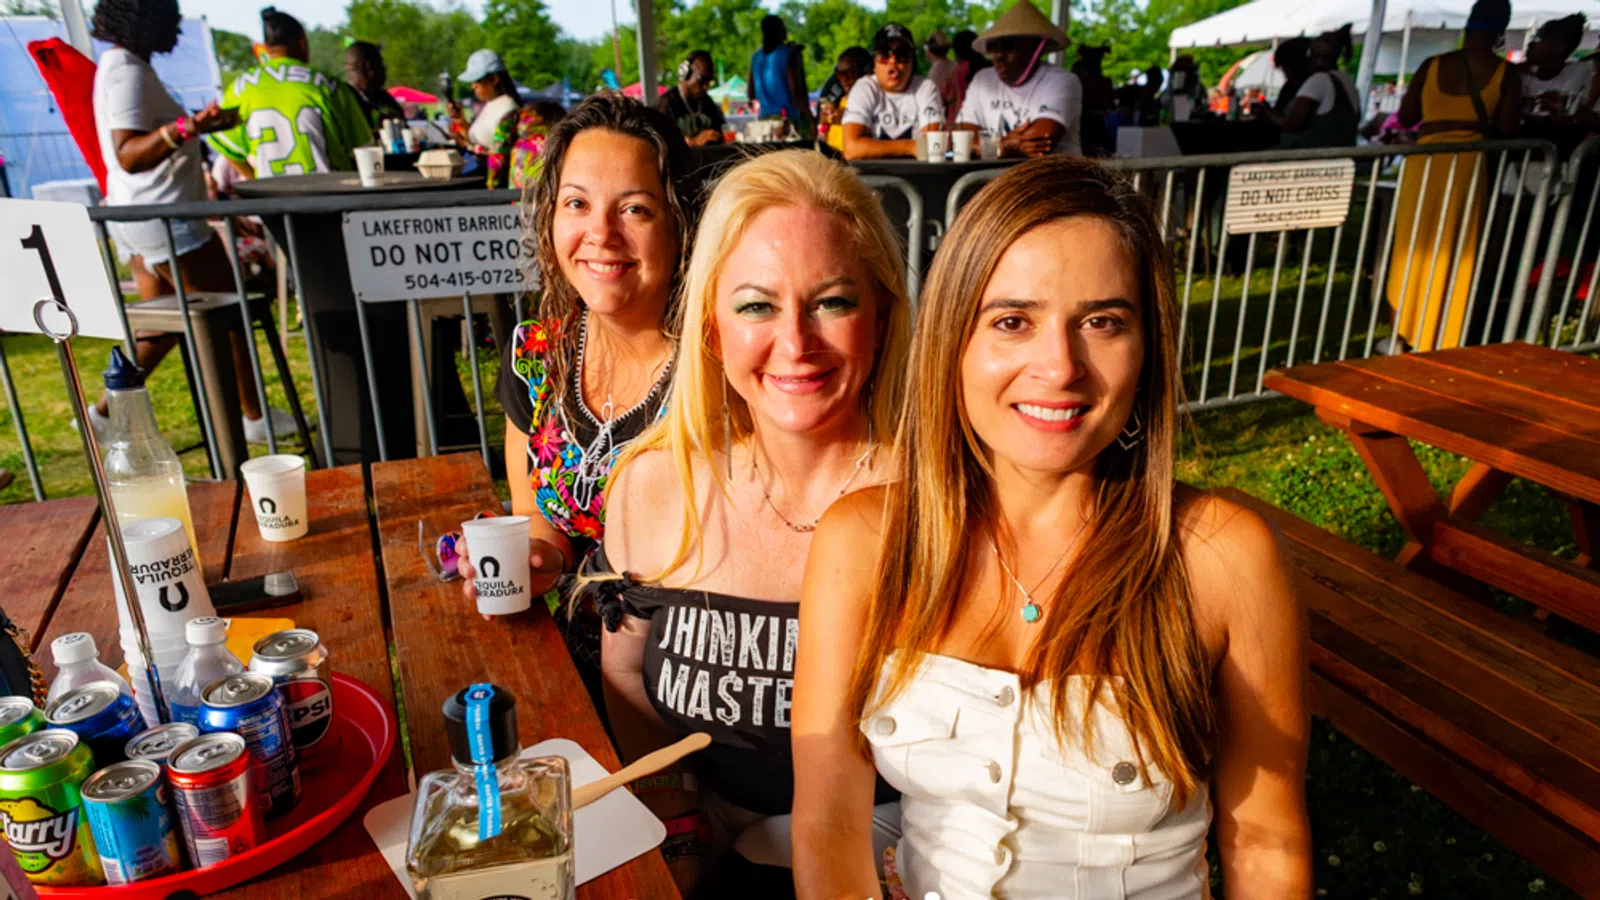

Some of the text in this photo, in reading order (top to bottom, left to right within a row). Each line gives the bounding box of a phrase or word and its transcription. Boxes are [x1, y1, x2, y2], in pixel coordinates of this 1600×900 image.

[1241, 169, 1292, 182] LAKEFRONT
[1240, 185, 1341, 206] DO NOT CROSS
[362, 214, 522, 237] LAKEFRONT BARRICA
[370, 237, 536, 267] DO NOT CROS
[20, 224, 68, 312] 1
[405, 268, 525, 290] 504-415-0725
[135, 561, 194, 585] TEQUILA
[657, 657, 795, 728] MA$TE
[0, 809, 76, 858] tarry
